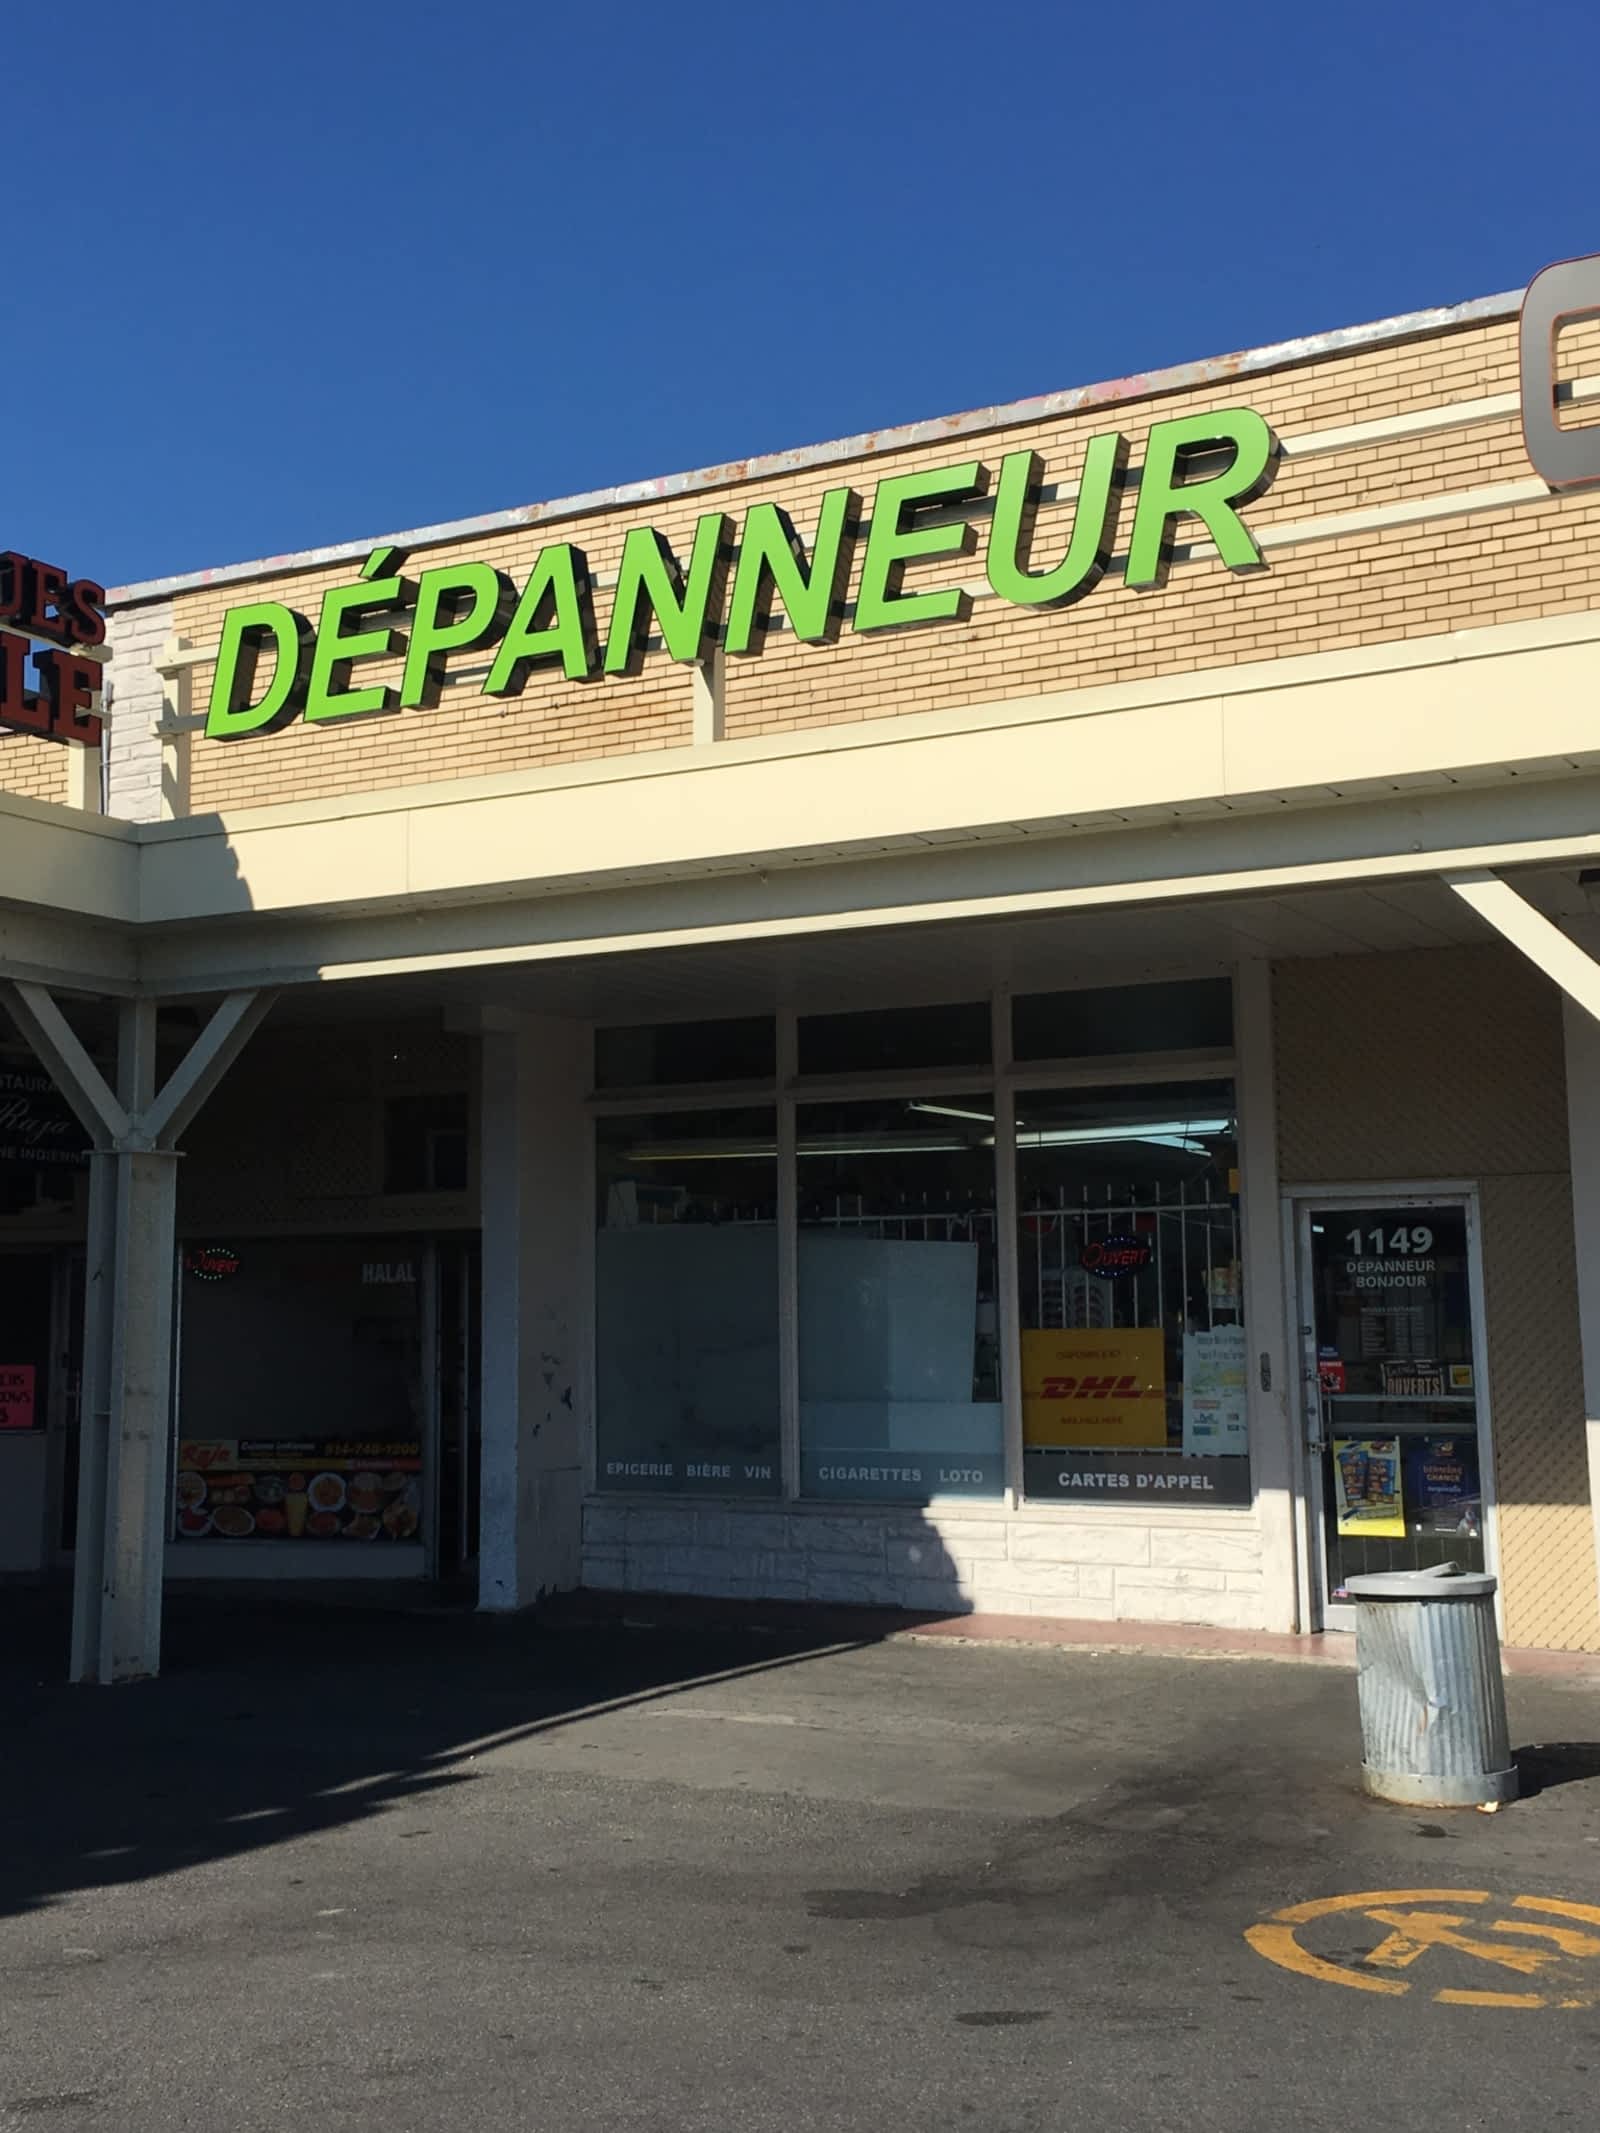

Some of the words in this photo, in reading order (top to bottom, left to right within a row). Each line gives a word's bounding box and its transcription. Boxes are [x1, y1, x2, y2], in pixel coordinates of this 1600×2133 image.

[204, 406, 1280, 741] DÉPANNEUR
[1346, 1226, 1433, 1255] 1149
[362, 1263, 416, 1284] HALAL
[1356, 1275, 1427, 1288] BONJOUR
[1040, 1376, 1144, 1400] DHL
[744, 1465, 772, 1479] VIN
[818, 1466, 922, 1483] CIGARETTES
[939, 1469, 985, 1484] LOTO
[1058, 1471, 1131, 1488] CARTES
[1136, 1472, 1215, 1490] D'APPEL
